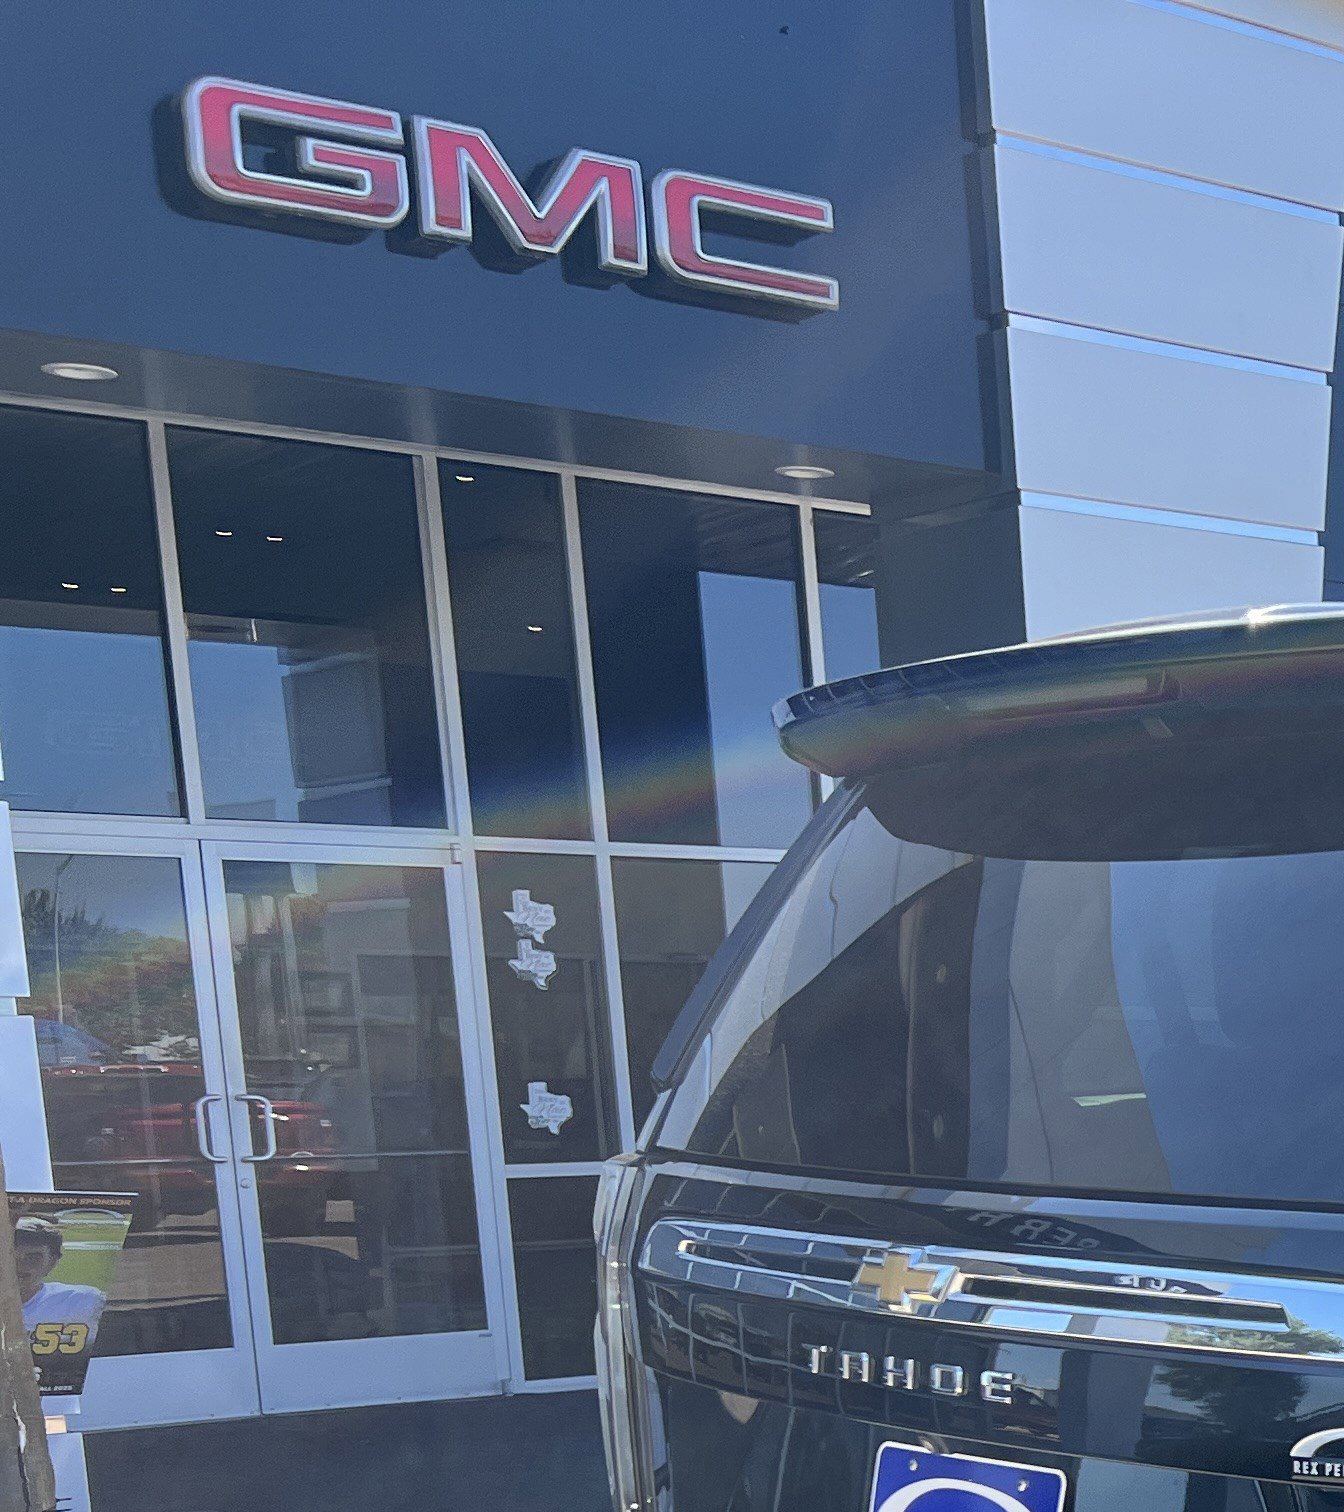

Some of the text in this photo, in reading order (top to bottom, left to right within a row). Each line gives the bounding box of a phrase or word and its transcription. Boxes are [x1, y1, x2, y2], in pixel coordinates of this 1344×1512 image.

[182, 75, 840, 309] GMC
[28, 1196, 78, 1206] DRAGON
[79, 1197, 132, 1206] SPONSOR
[31, 1322, 90, 1355] 53
[801, 1343, 1015, 1404] TAHOE
[1293, 1460, 1319, 1476] REX
